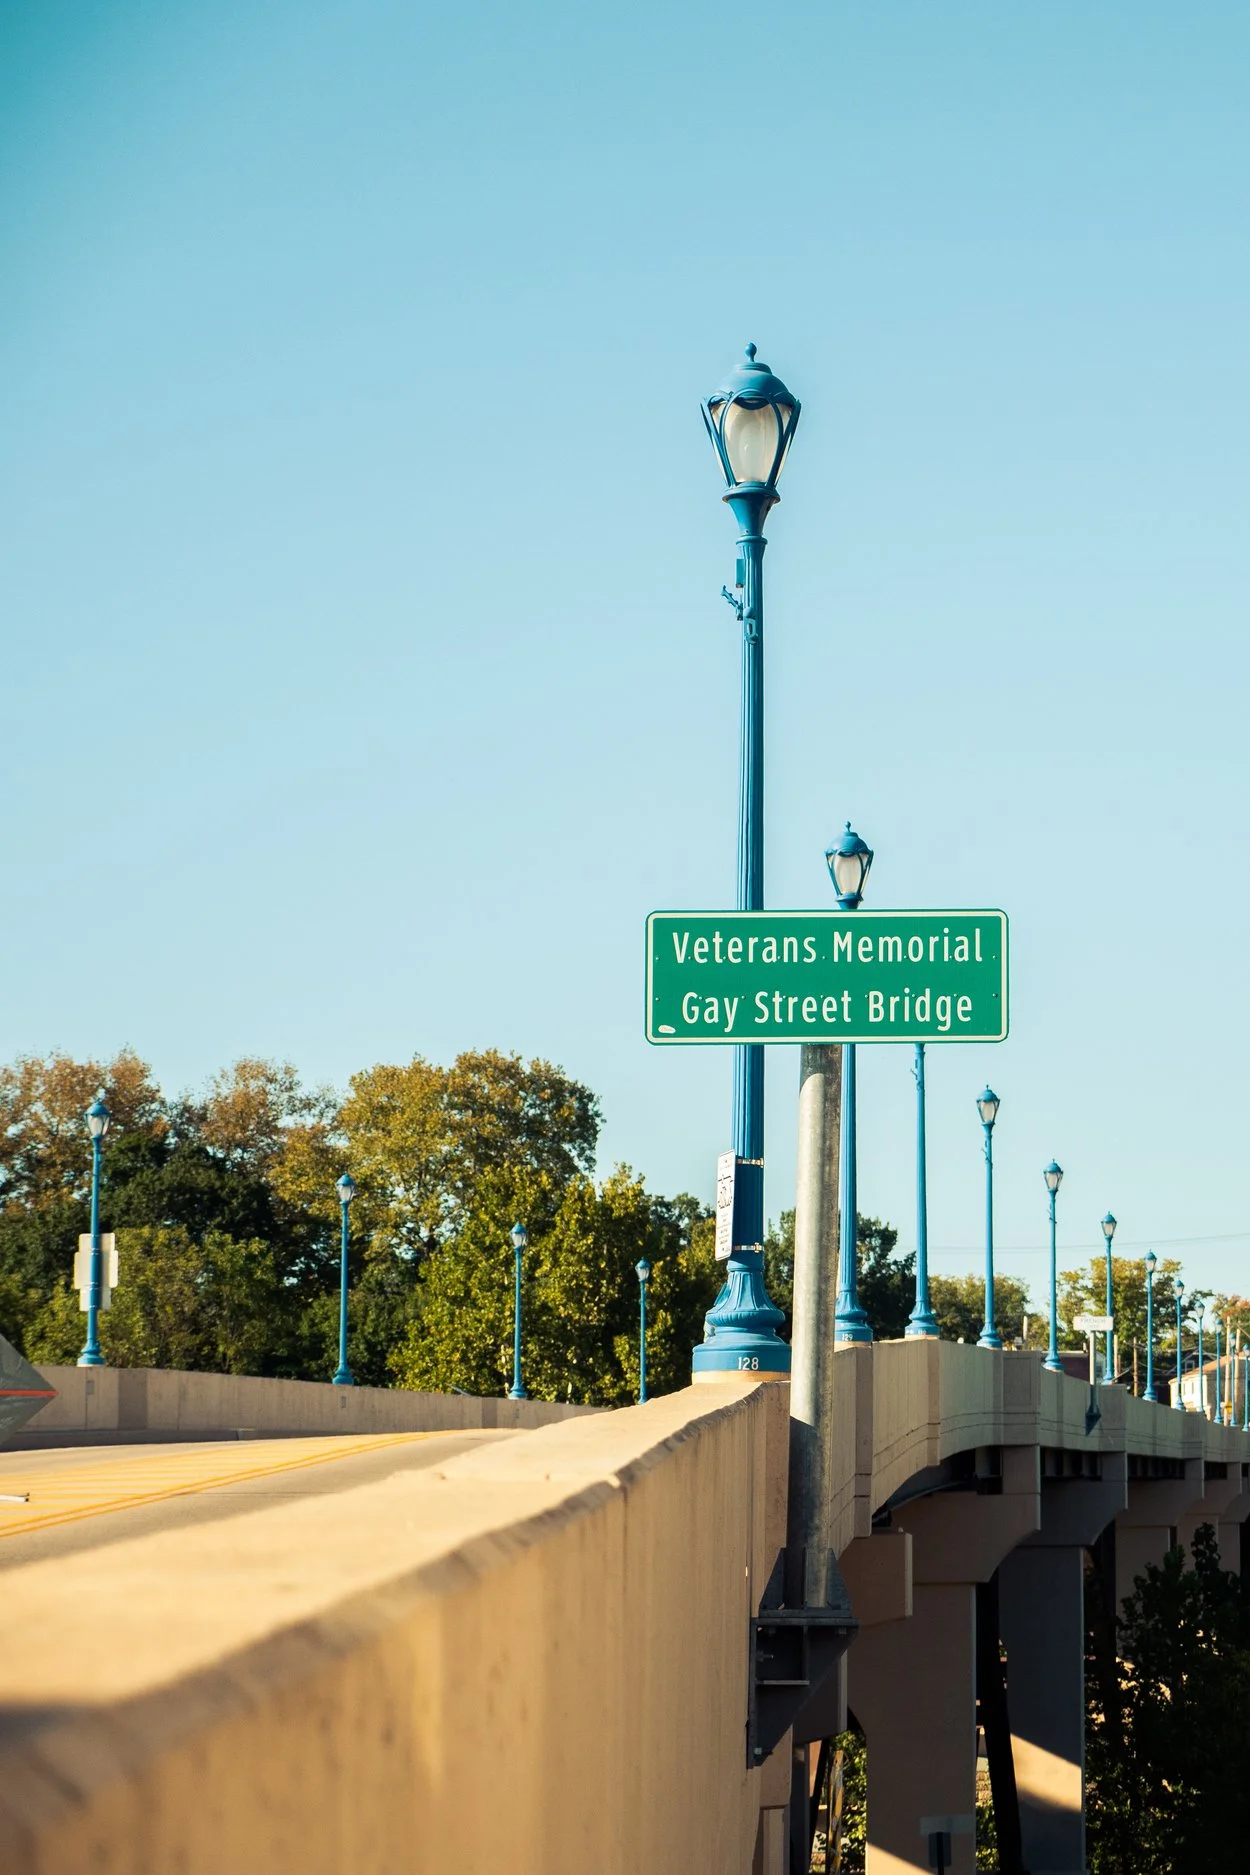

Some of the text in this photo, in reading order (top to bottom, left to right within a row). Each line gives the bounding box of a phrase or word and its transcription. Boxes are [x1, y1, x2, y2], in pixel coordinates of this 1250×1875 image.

[672, 927, 983, 964] Veterans Memorial
[681, 987, 973, 1033] Gay Street Bridge
[737, 1356, 759, 1370] 128
